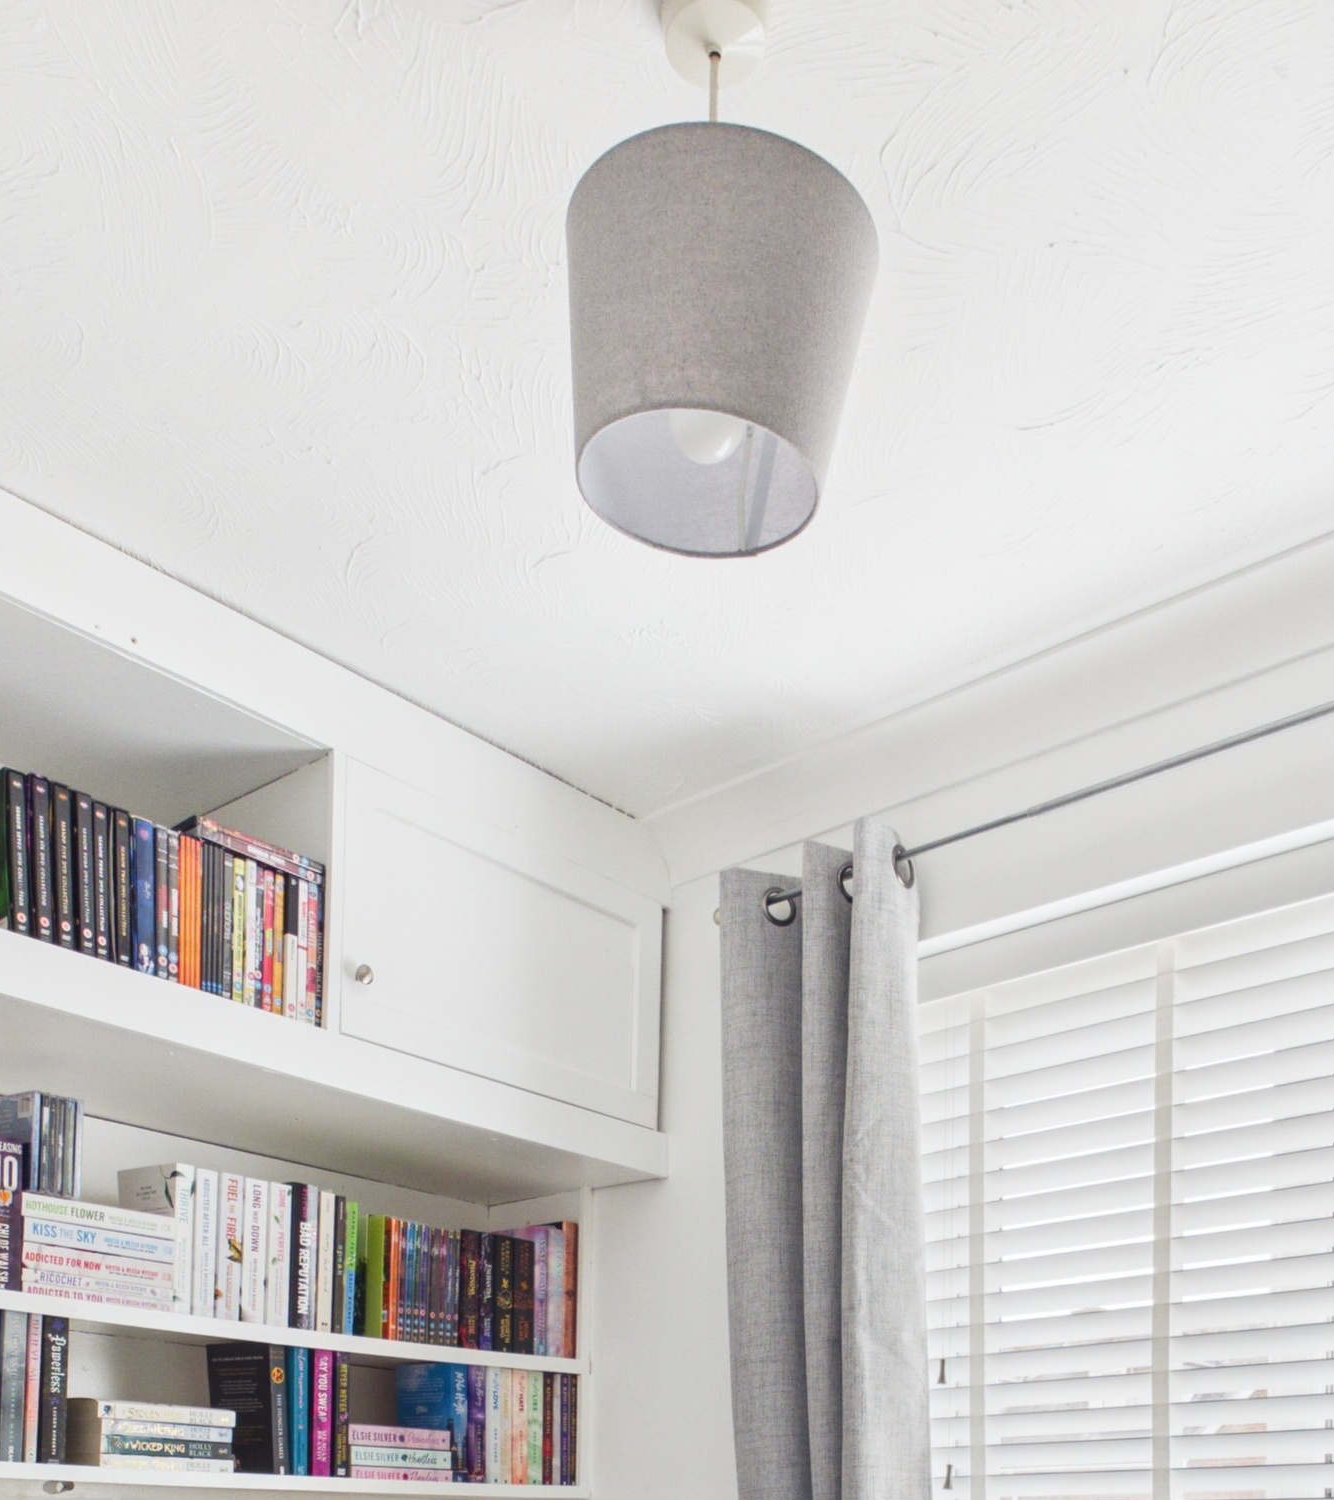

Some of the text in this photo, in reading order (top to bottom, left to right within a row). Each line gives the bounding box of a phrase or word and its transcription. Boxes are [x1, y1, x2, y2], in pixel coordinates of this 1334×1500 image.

[227, 1178, 238, 1203] FUEL
[252, 1184, 262, 1209] LONG
[25, 1199, 105, 1223] HOTHOUSE FLOWER
[32, 1222, 58, 1238] KISS
[76, 1229, 97, 1245] SKY
[226, 1216, 237, 1240] FIRE
[251, 1225, 260, 1252] DOWN
[24, 1251, 102, 1271] ADDICTED FOR NOW
[297, 1221, 312, 1315] BAD REPUTATION
[40, 1271, 82, 1287] RICOCHET
[352, 1431, 398, 1443] ELSIE SILVER
